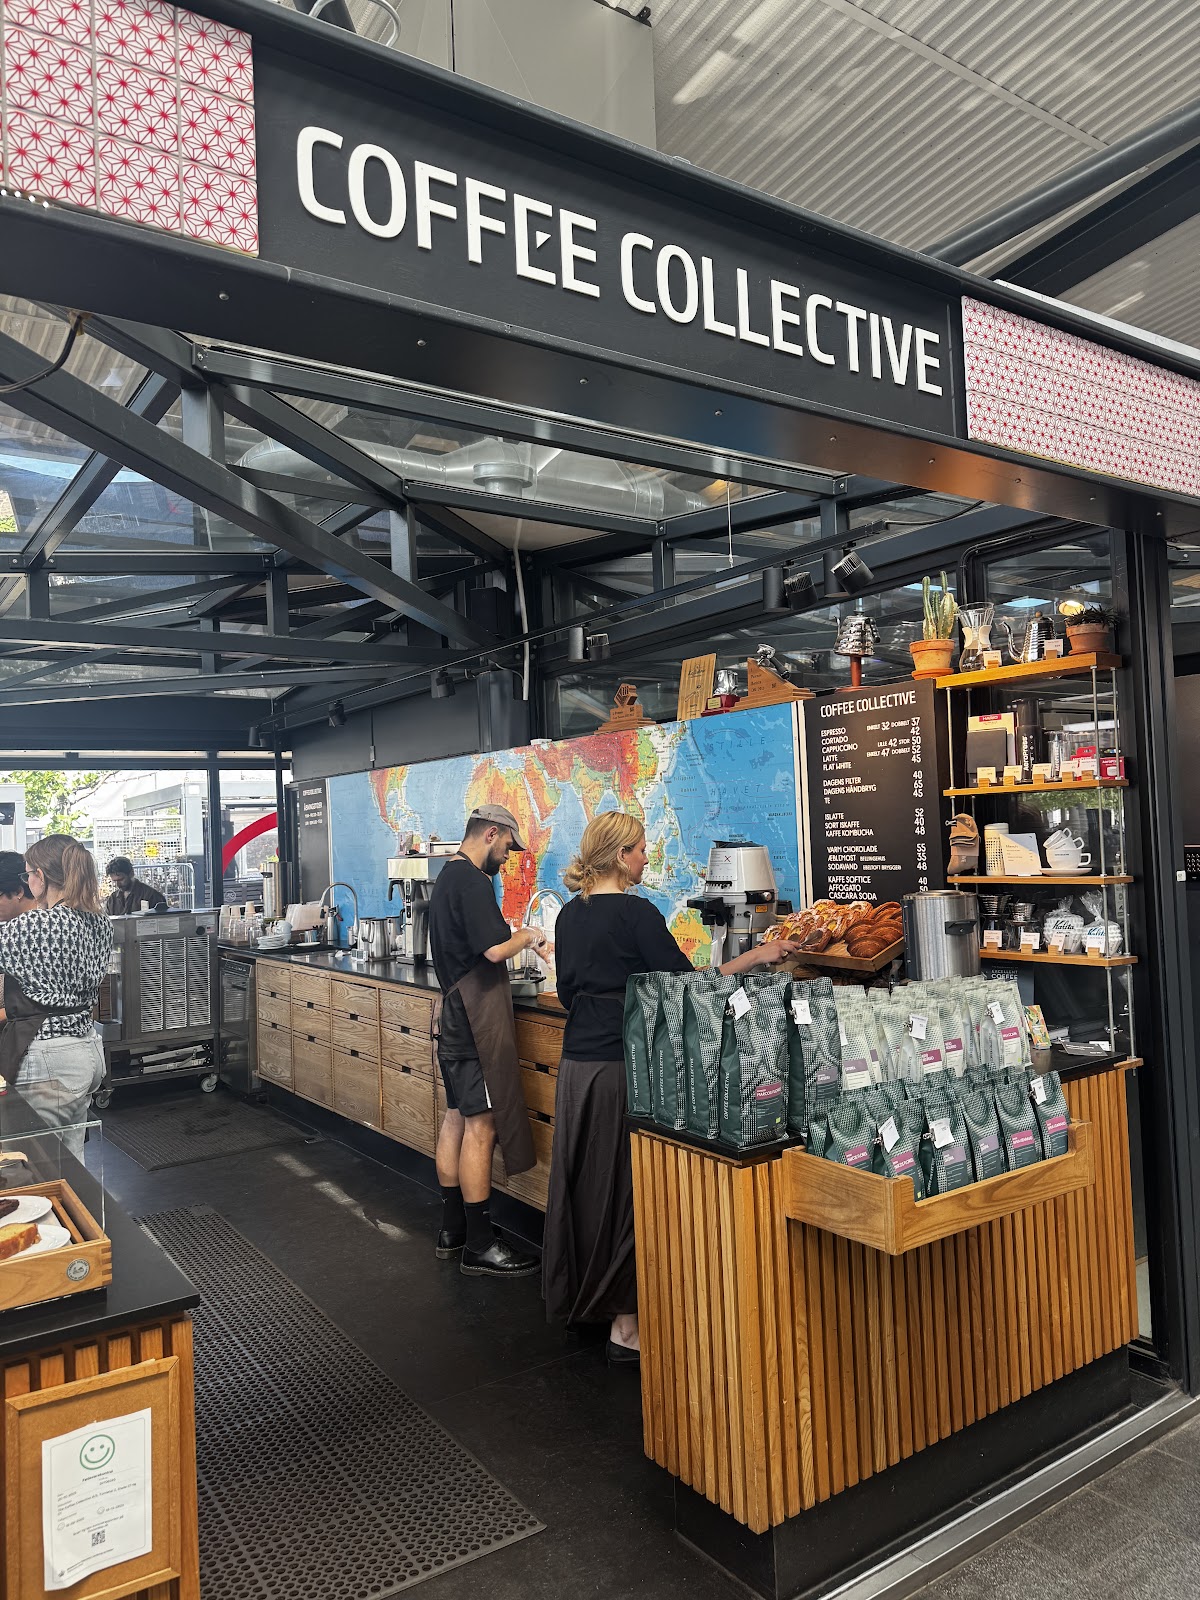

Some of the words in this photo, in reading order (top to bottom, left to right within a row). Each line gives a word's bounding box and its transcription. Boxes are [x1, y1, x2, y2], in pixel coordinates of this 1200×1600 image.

[296, 124, 600, 298] COFFEE
[620, 231, 943, 397] COLLECTIVE
[820, 701, 855, 718] COFFEE
[856, 690, 916, 712] COLLECTIVE
[820, 728, 846, 737] ESPRESSO
[881, 721, 890, 730] 32
[911, 716, 920, 726] 37
[822, 736, 848, 745] CORTADO
[910, 726, 920, 735] 42
[822, 743, 858, 753] CAPPUCCINO
[888, 738, 897, 747] 42
[912, 736, 921, 744] 50
[823, 754, 838, 762] LATTE
[881, 748, 890, 757] 47
[912, 745, 921, 754] 52
[911, 754, 921, 763] 45
[823, 778, 844, 787] DAGENS
[845, 777, 861, 785] FILTER
[913, 770, 923, 779] 40
[846, 784, 877, 794] HÅNDBRYG
[914, 780, 923, 788] 65
[913, 789, 923, 798] 45
[914, 808, 924, 817] 52
[914, 817, 924, 826] 40
[914, 826, 925, 835] 48
[917, 843, 926, 852] 55
[917, 853, 927, 861] 35
[917, 862, 927, 870] 48
[918, 877, 928, 885] 40
